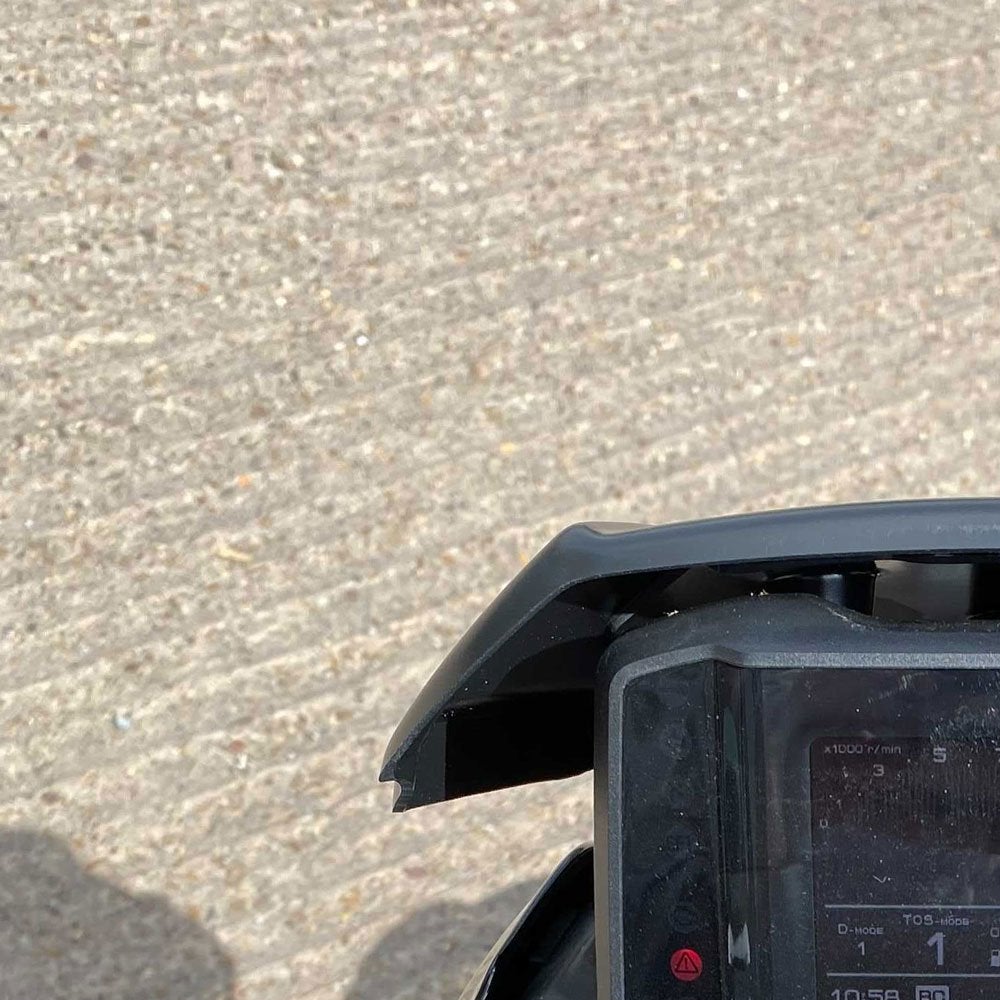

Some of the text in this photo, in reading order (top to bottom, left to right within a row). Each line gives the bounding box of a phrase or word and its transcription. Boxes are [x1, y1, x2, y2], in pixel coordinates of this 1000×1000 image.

[933, 748, 946, 763] 5
[872, 764, 885, 777] 3
[837, 923, 884, 935] D-MODE
[857, 941, 865, 956] 1
[926, 932, 945, 966] 1
